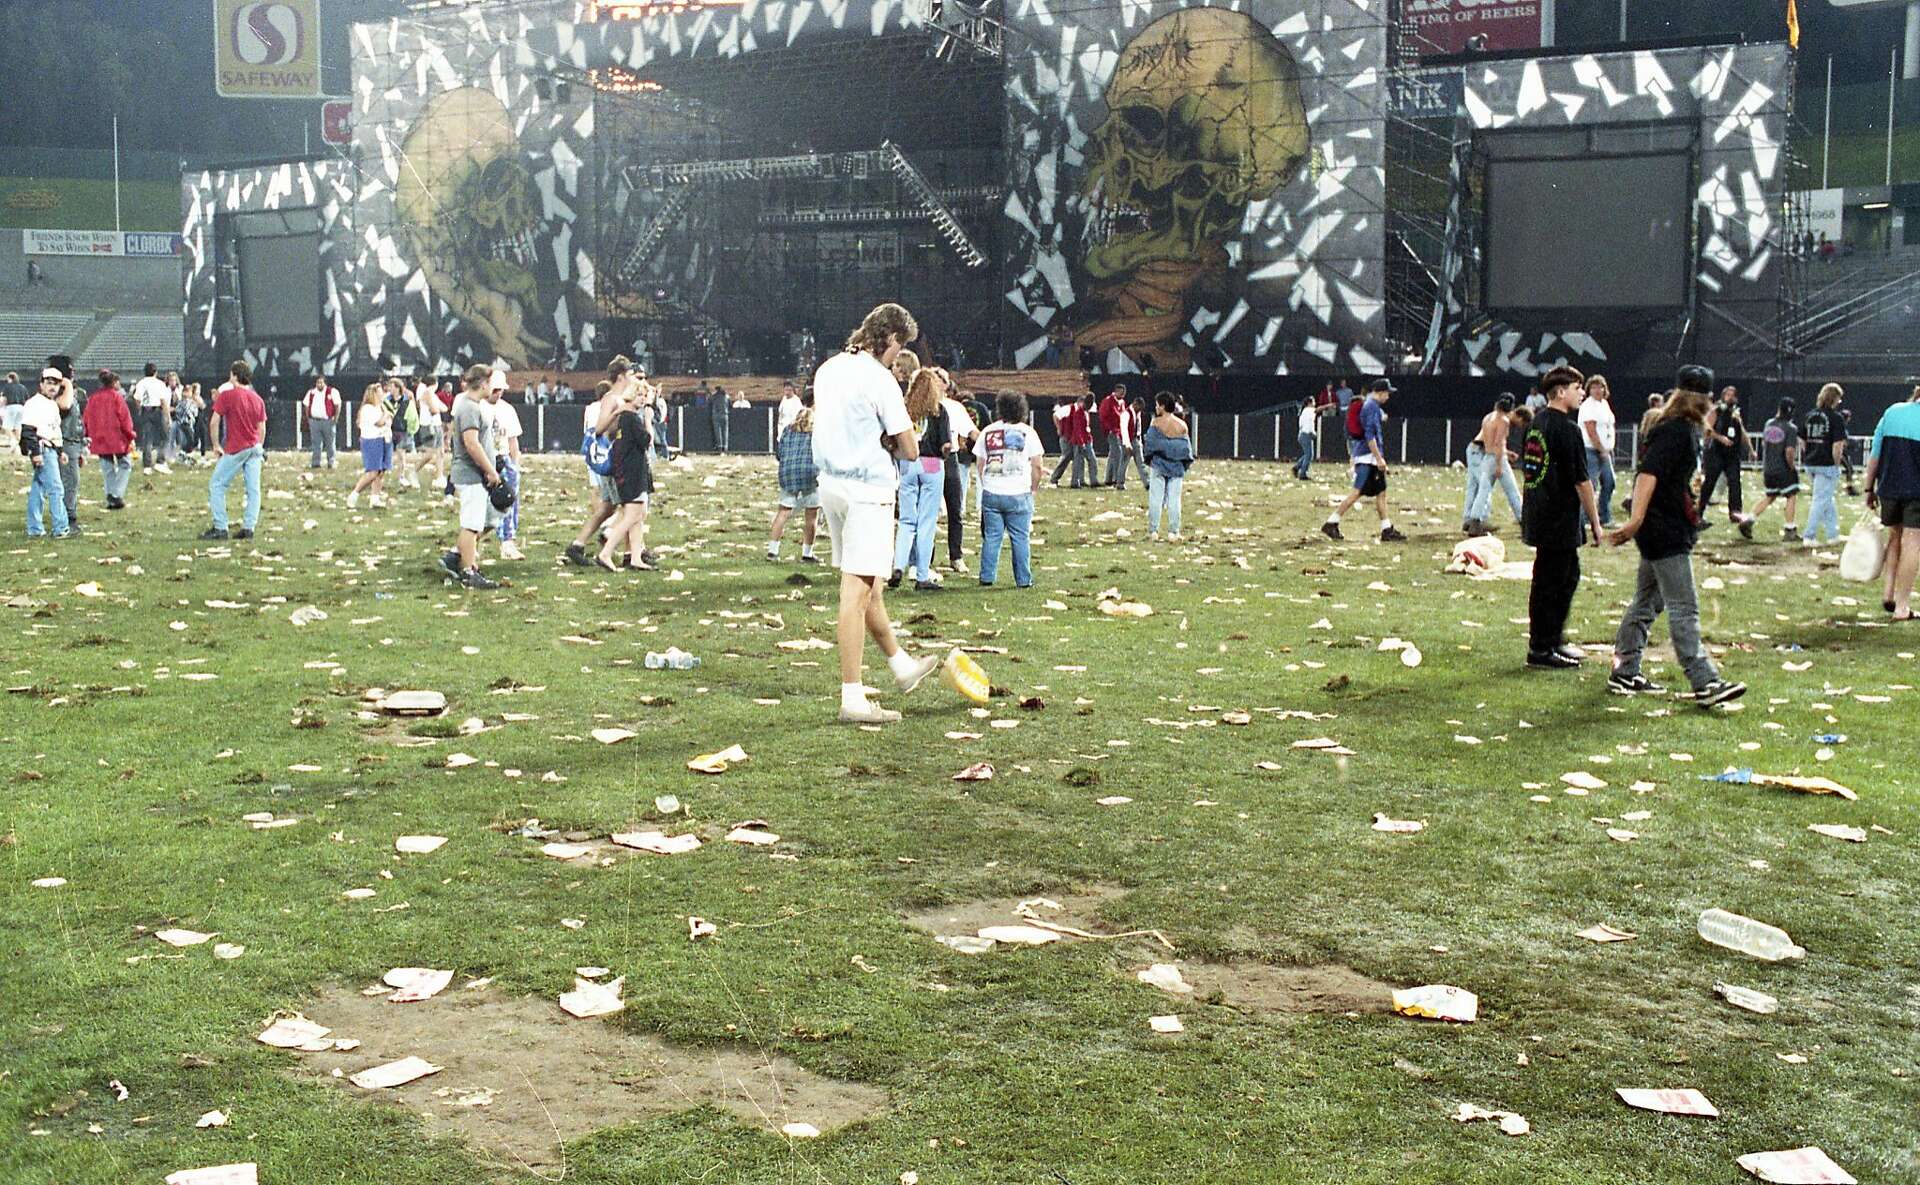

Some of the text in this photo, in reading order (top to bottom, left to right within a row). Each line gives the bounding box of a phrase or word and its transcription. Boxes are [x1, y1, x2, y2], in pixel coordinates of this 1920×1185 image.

[1408, 6, 1535, 25] KING OF BEERS
[222, 71, 315, 87] SAFEWAY
[1388, 83, 1447, 111] NK
[65, 232, 89, 242] KNOW
[127, 234, 173, 254] CLOROX
[66, 243, 91, 253] WHEN
